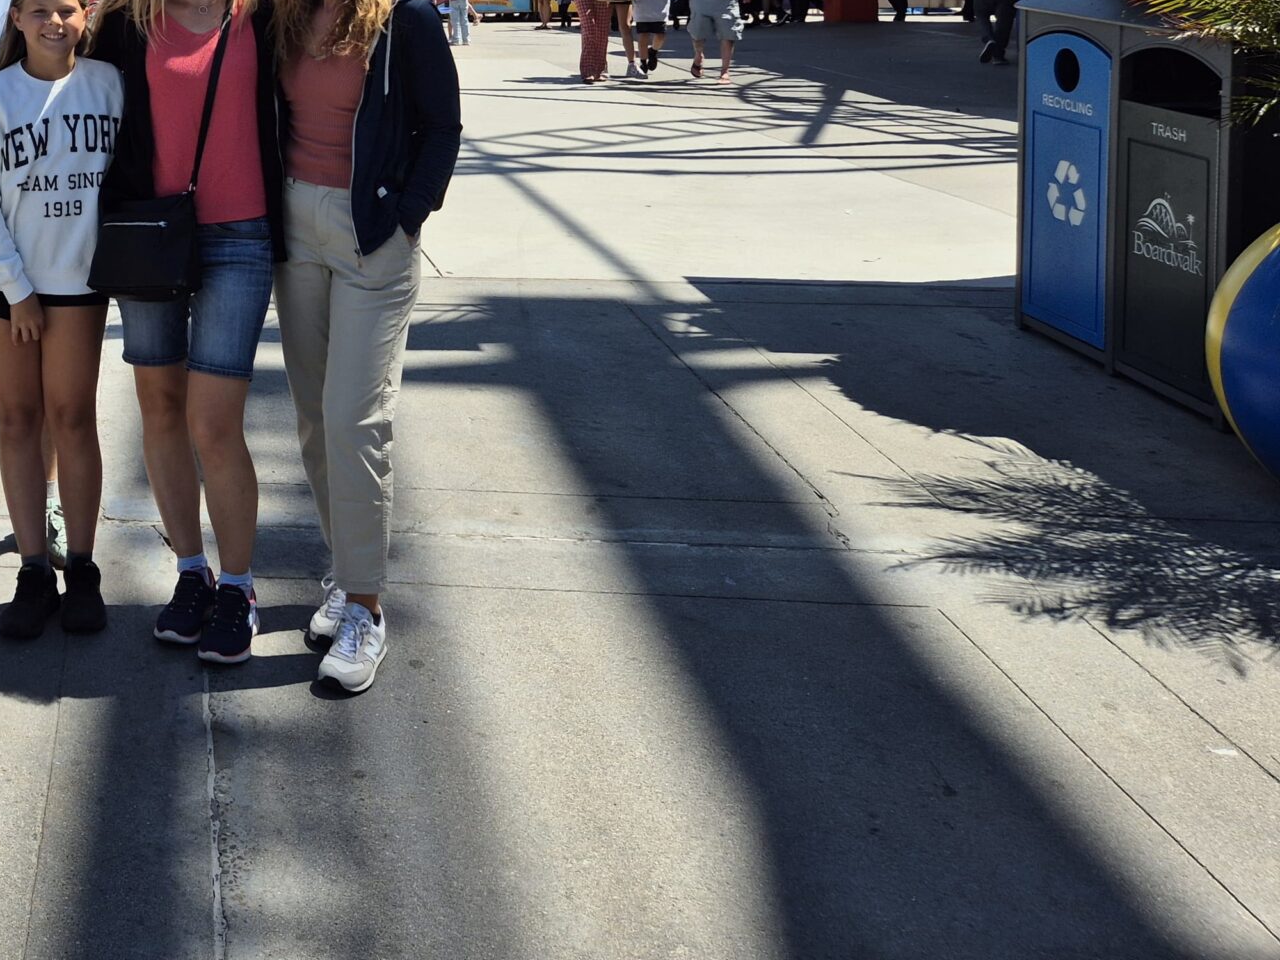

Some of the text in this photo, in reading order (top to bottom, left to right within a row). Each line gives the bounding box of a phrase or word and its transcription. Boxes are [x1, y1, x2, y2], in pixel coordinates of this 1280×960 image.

[1042, 93, 1094, 116] RECYCLING
[1151, 122, 1187, 142] TRASH
[68, 171, 104, 190] SINC
[44, 200, 82, 218] 1919
[1132, 230, 1204, 277] Boardwalk
